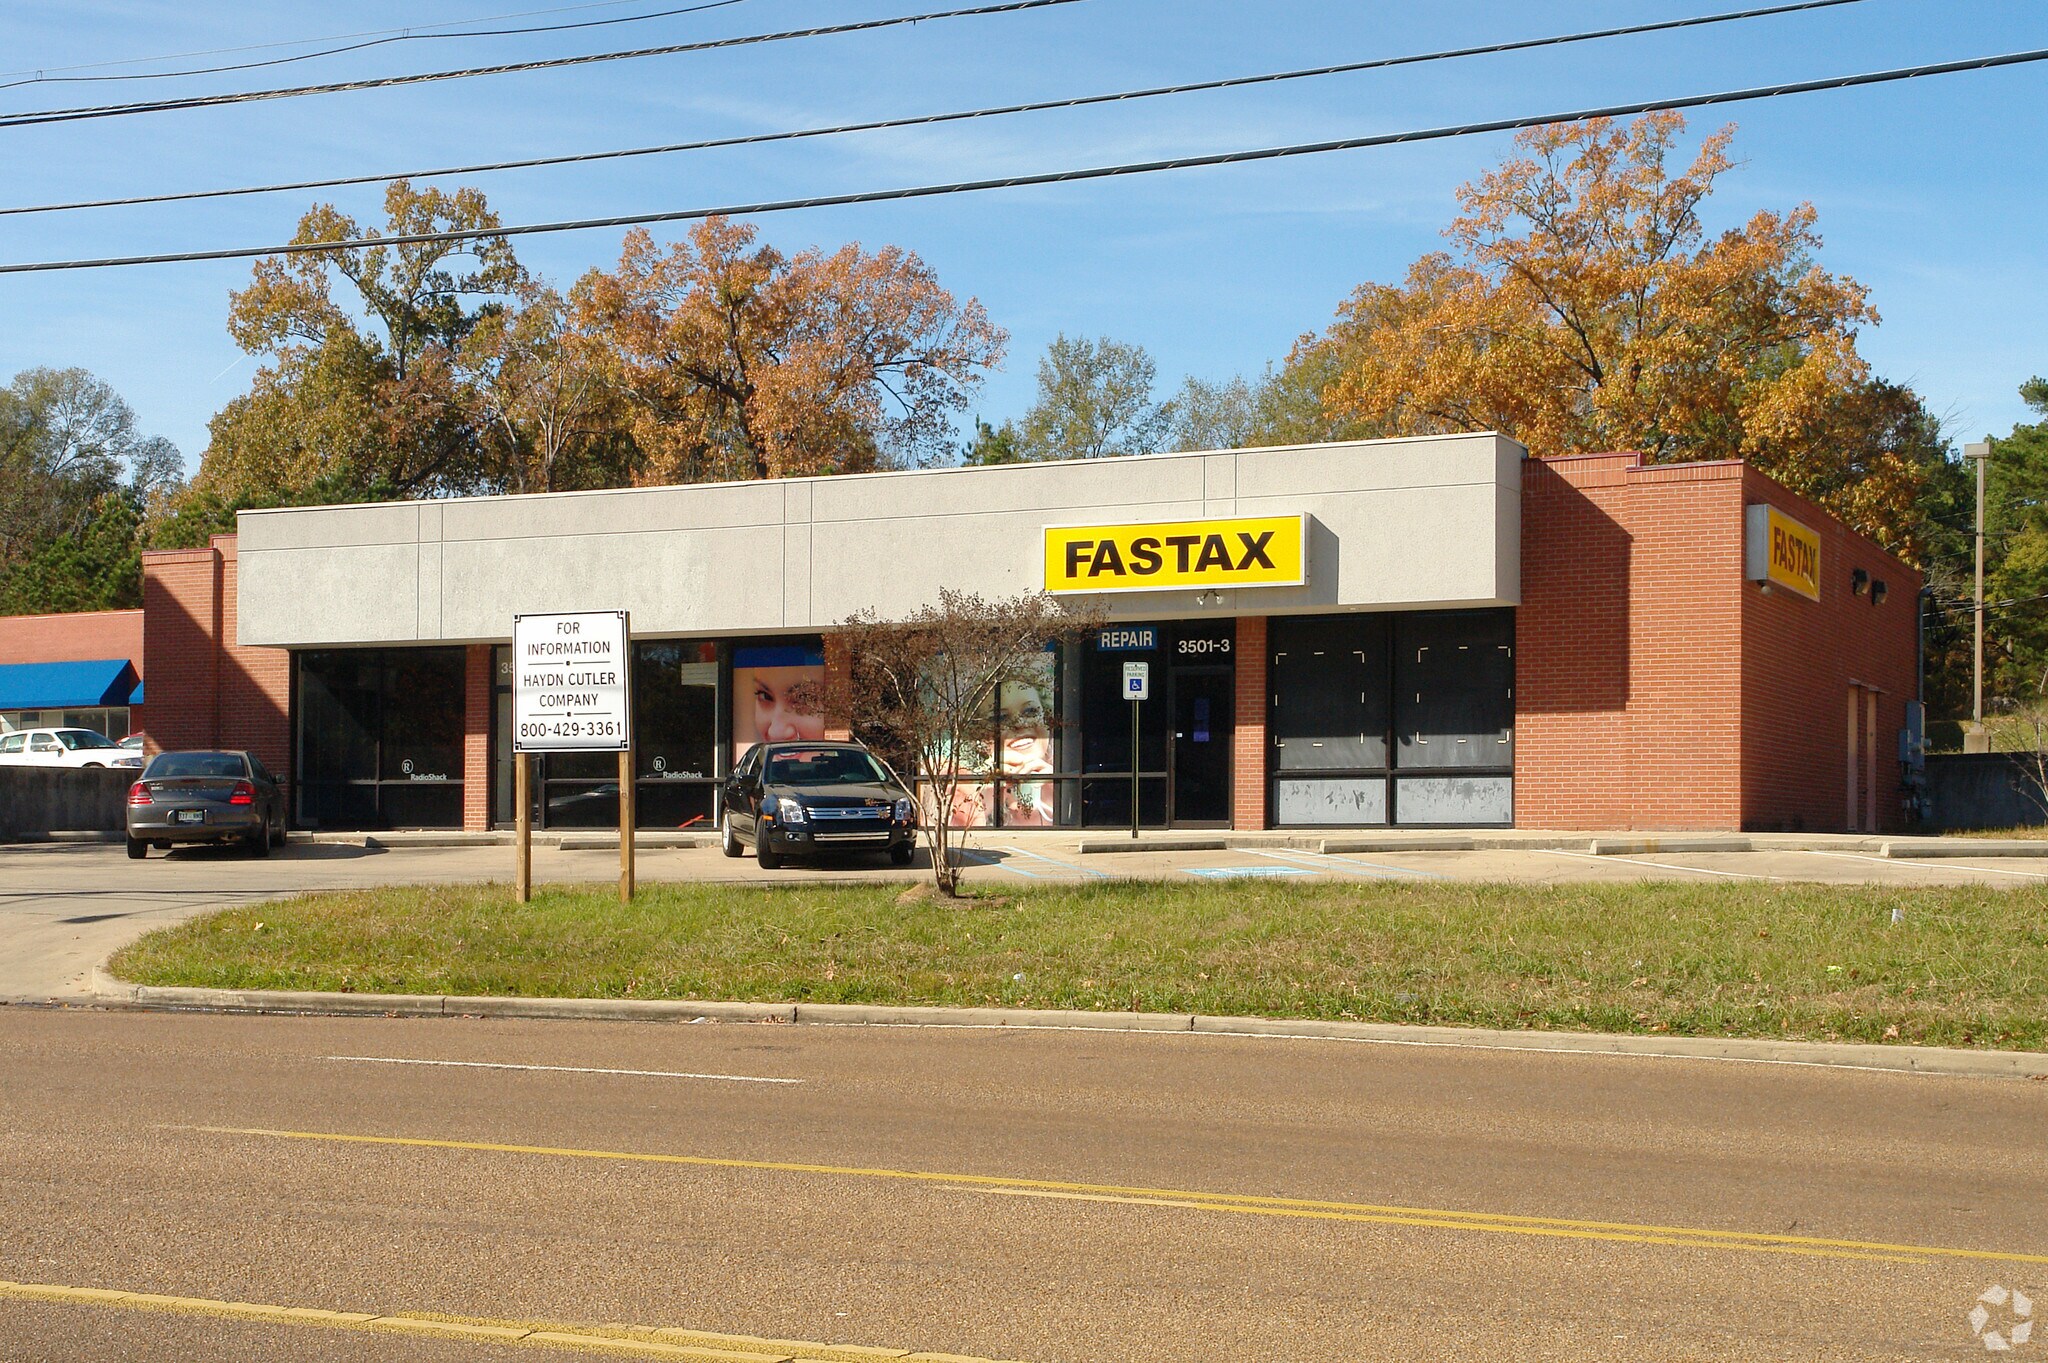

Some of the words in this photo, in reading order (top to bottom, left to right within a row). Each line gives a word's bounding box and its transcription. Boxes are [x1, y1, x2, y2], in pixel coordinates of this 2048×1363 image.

[1065, 531, 1276, 578] FASTAX
[1774, 526, 1816, 585] FASTAX
[557, 622, 580, 635] FOR
[1101, 630, 1153, 648] REPAIR
[1178, 639, 1231, 654] 3501-3
[527, 641, 611, 656] INFORMATION
[523, 673, 564, 687] HAYDN
[568, 672, 616, 686] CUTLER
[539, 693, 599, 707] COMPANY
[520, 721, 621, 737] 800-429-3361
[410, 773, 448, 781] RadioShack
[662, 771, 703, 779] RadioShack
